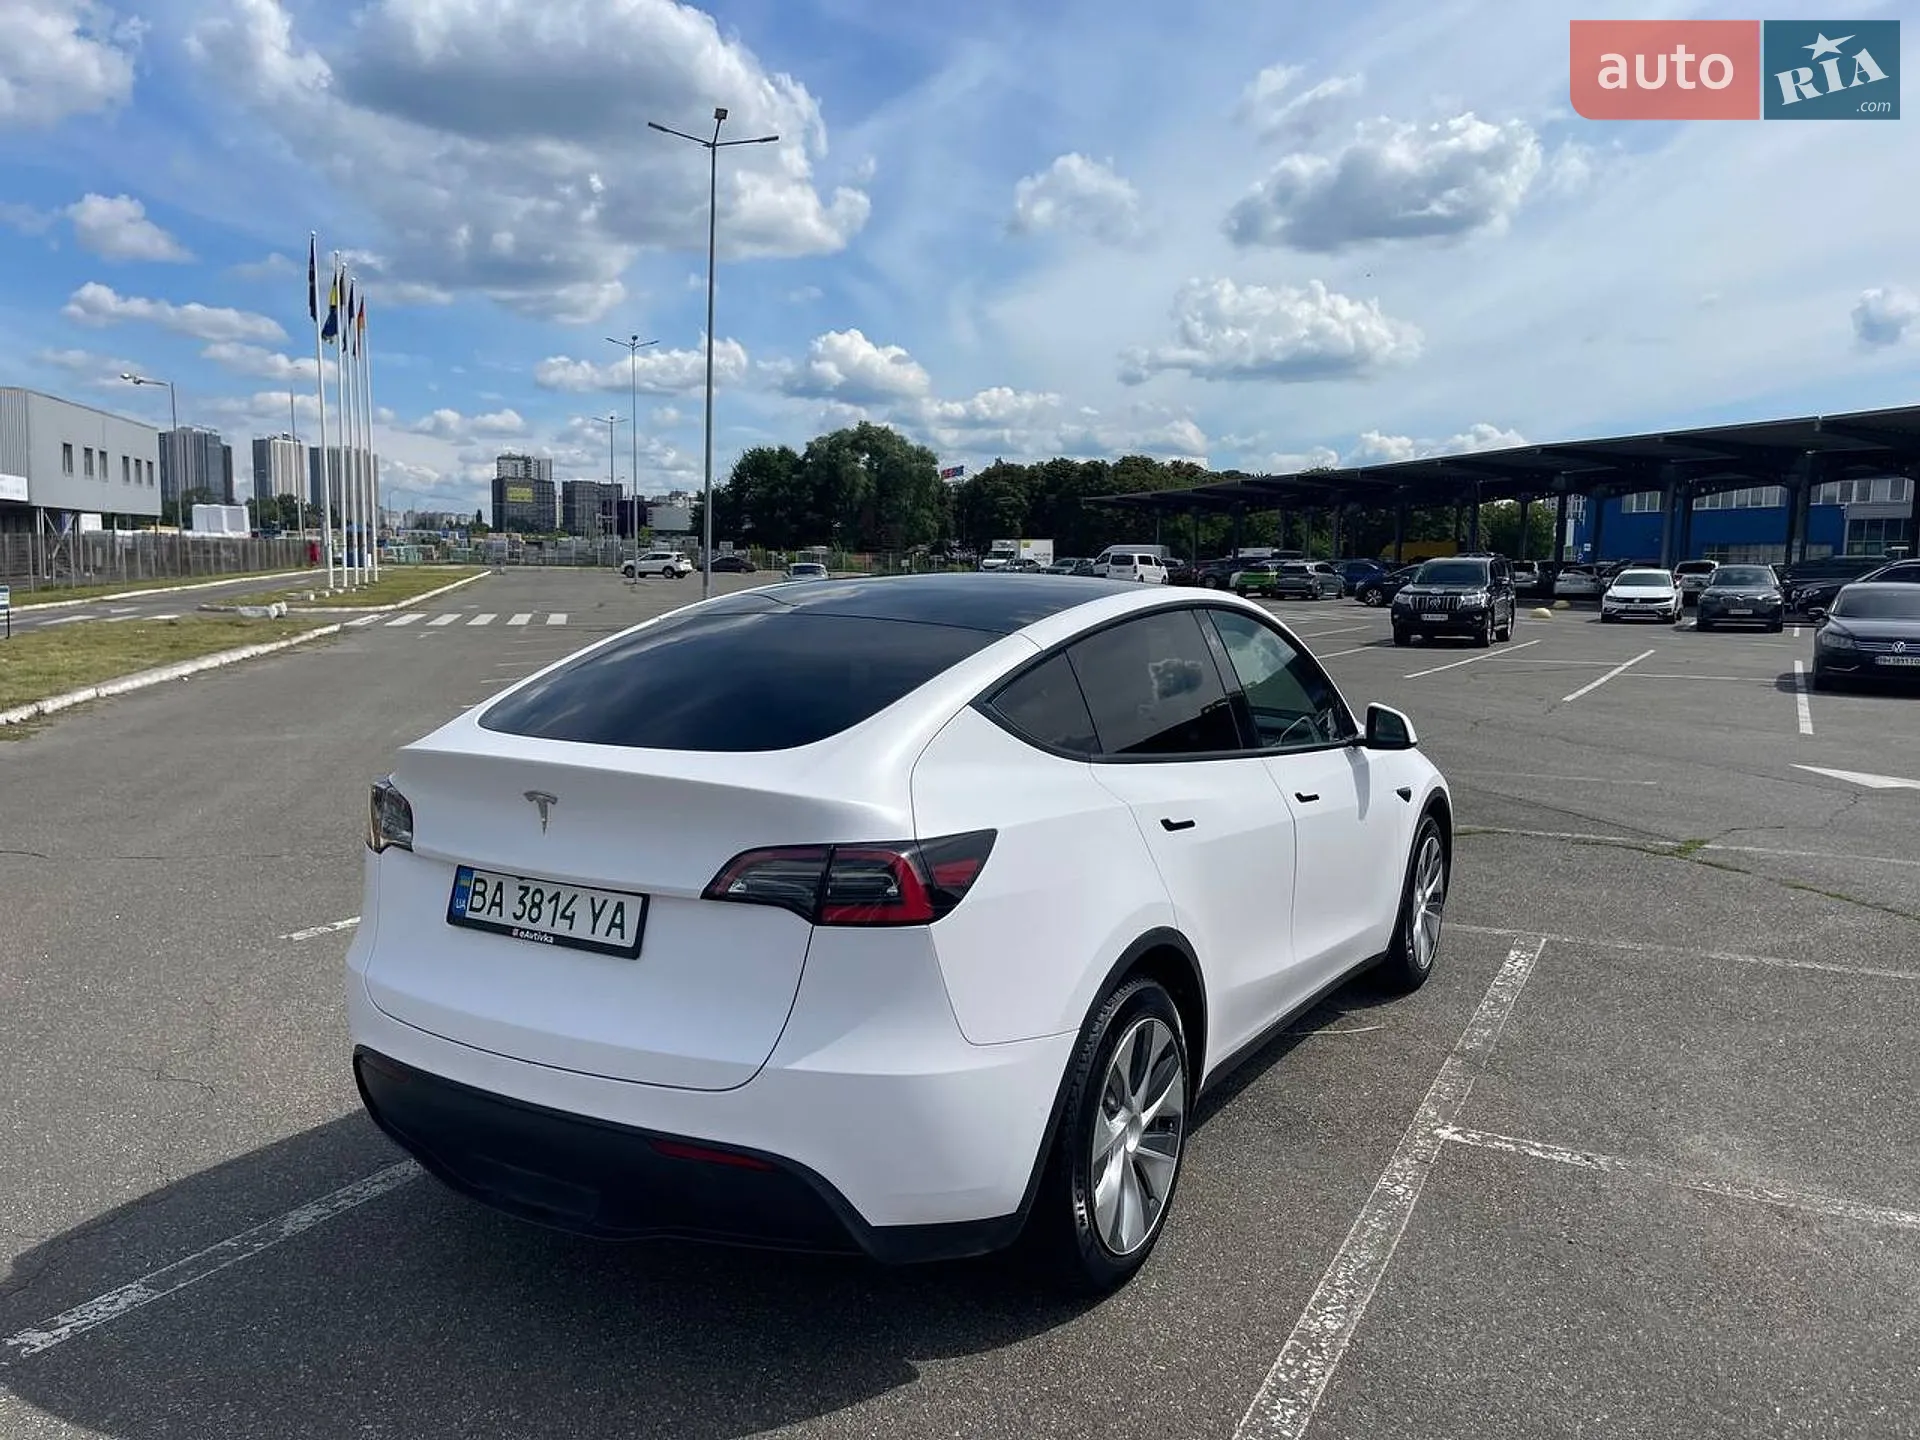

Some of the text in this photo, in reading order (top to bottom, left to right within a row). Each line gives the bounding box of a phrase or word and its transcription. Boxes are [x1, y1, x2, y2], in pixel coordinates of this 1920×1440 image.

[469, 877, 625, 939] BA 3814 YA
